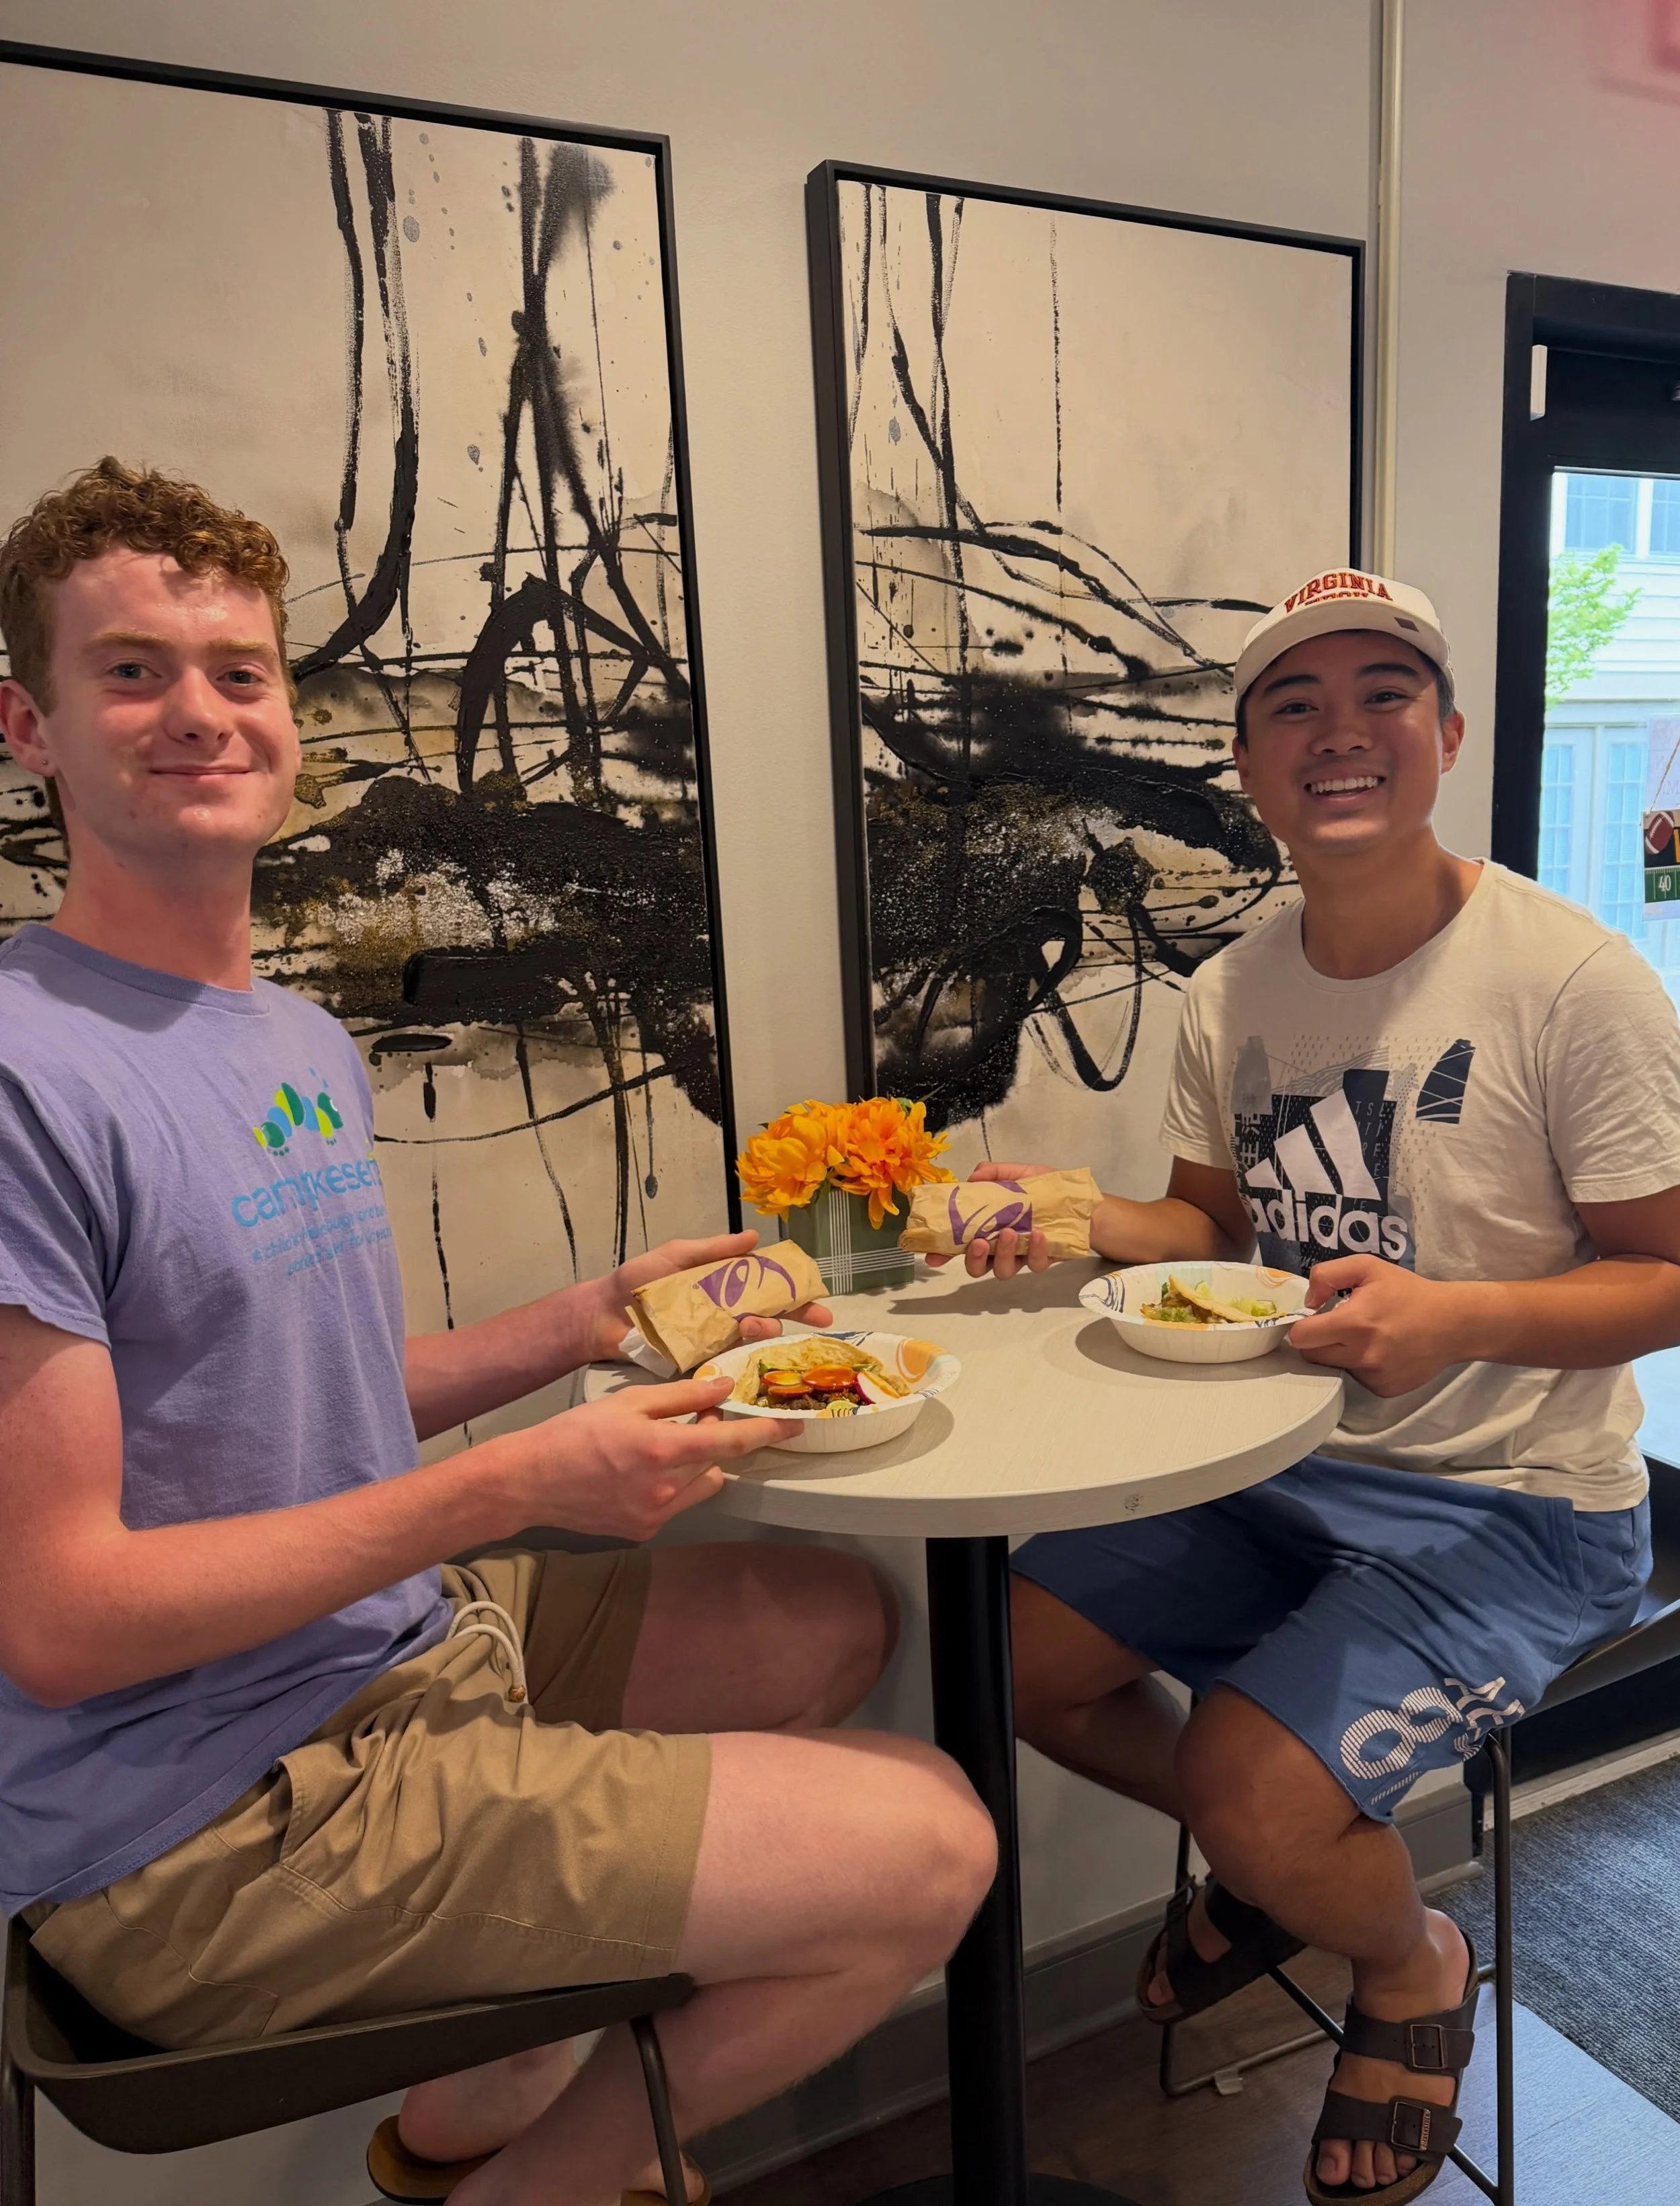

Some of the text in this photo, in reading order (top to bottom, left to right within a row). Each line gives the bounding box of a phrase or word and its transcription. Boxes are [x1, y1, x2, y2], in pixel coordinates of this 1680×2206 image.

[1284, 572, 1394, 614] VIRGINIA
[1658, 874, 1672, 893] 40
[1242, 1188, 1409, 1260] adidas
